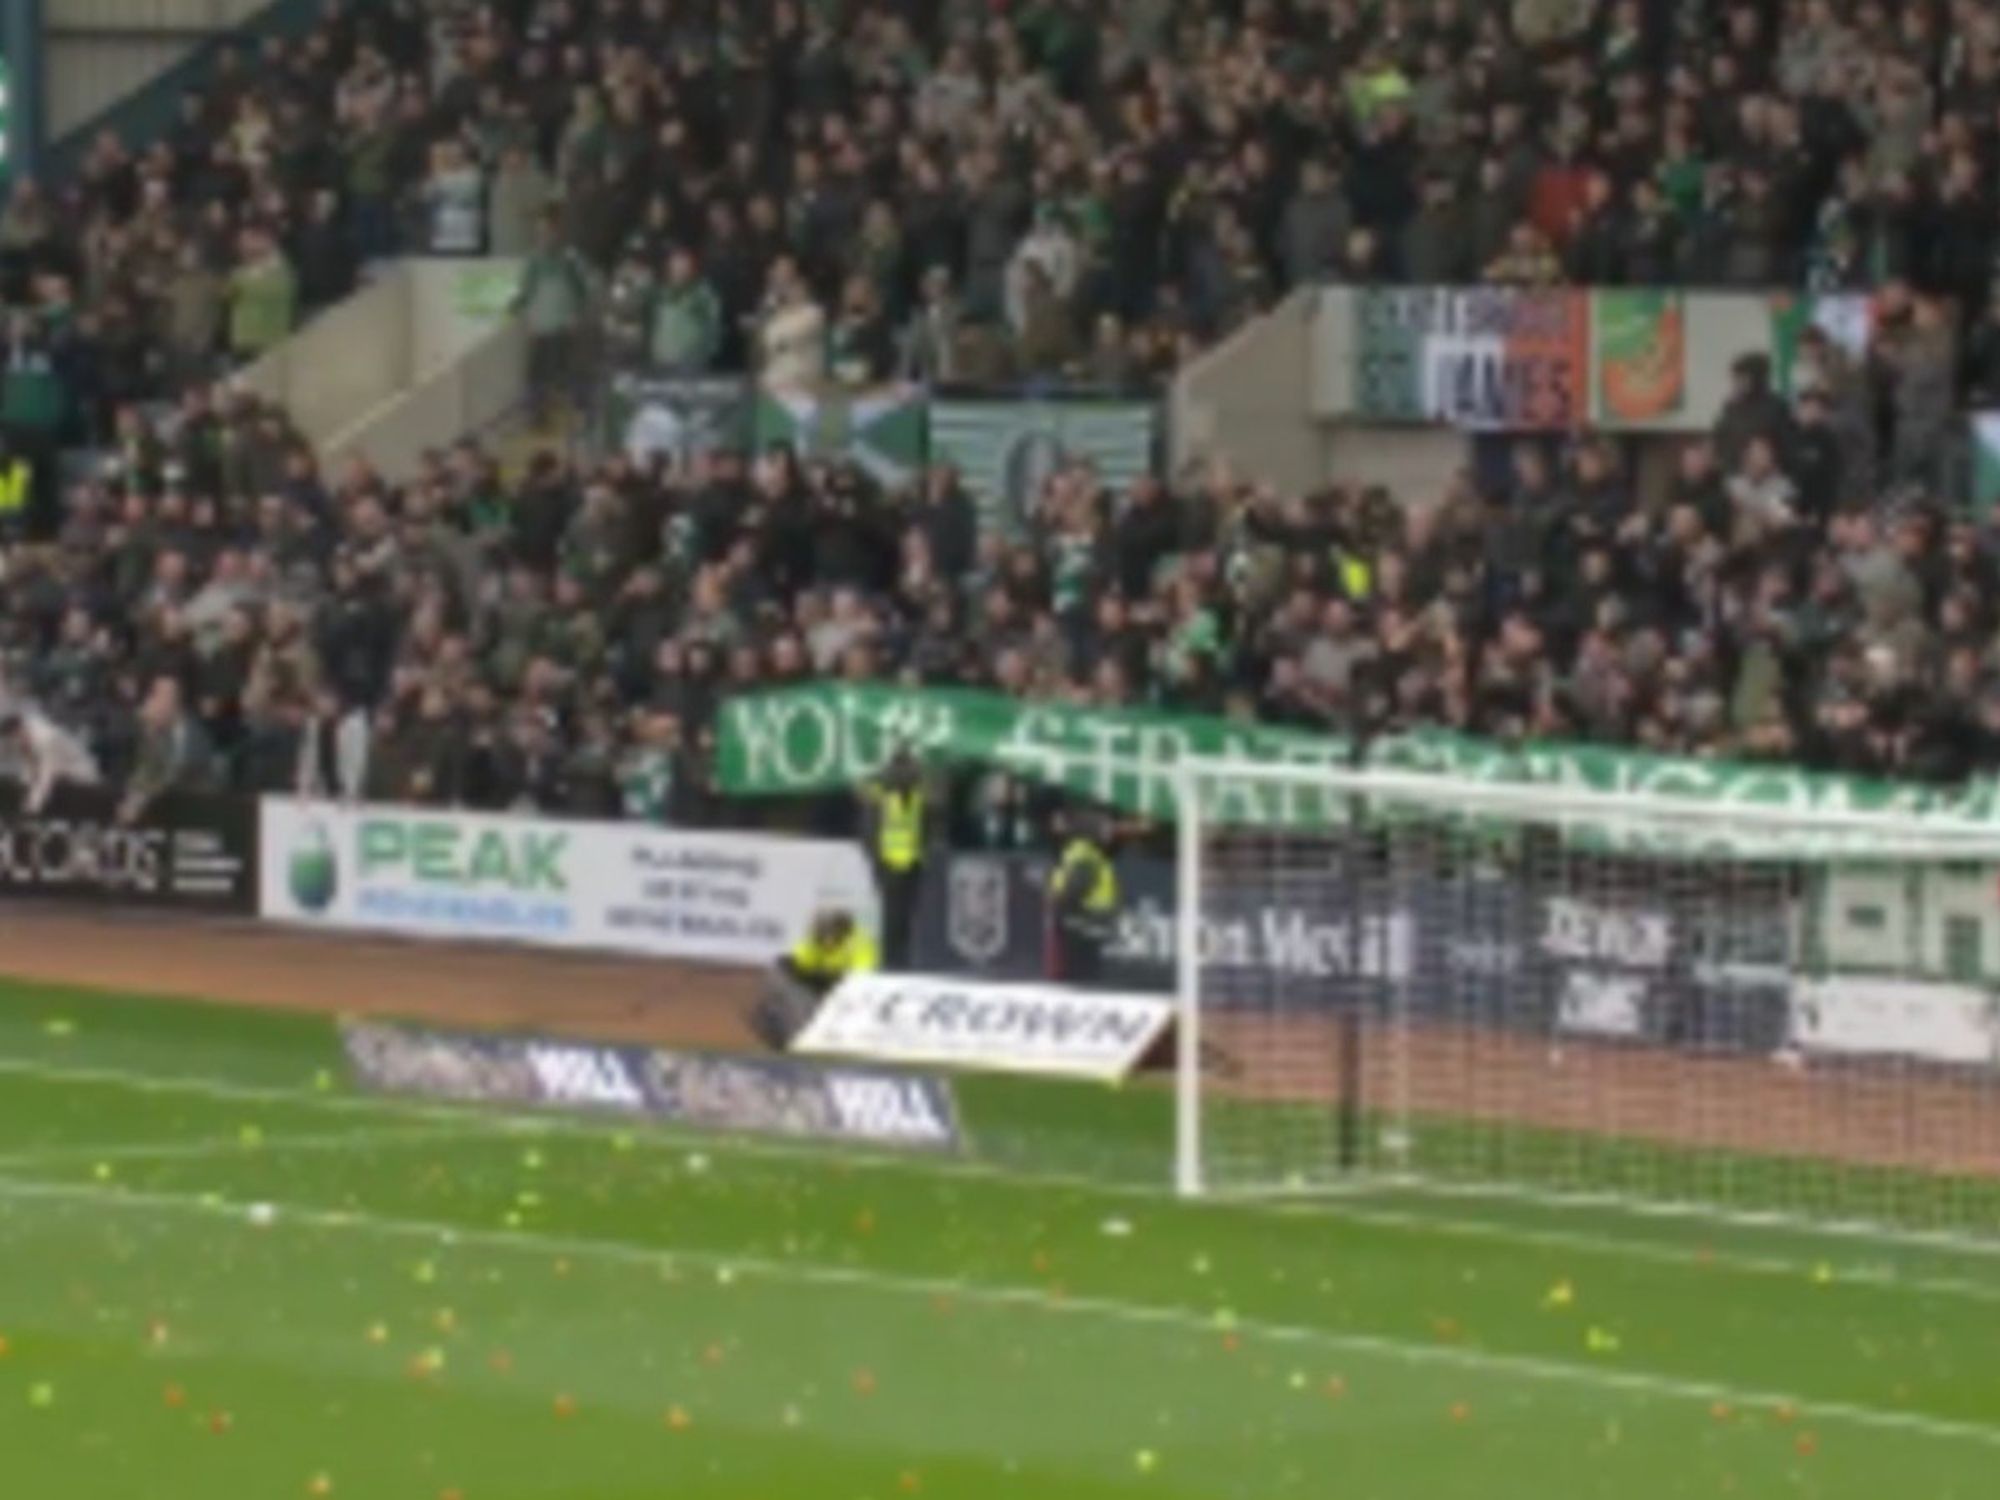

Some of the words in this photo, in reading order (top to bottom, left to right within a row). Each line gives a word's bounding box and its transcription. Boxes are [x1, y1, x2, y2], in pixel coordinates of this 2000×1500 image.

[0, 818, 166, 892] CORDS
[357, 818, 571, 892] PEAK
[876, 990, 1152, 1045] CROWN
